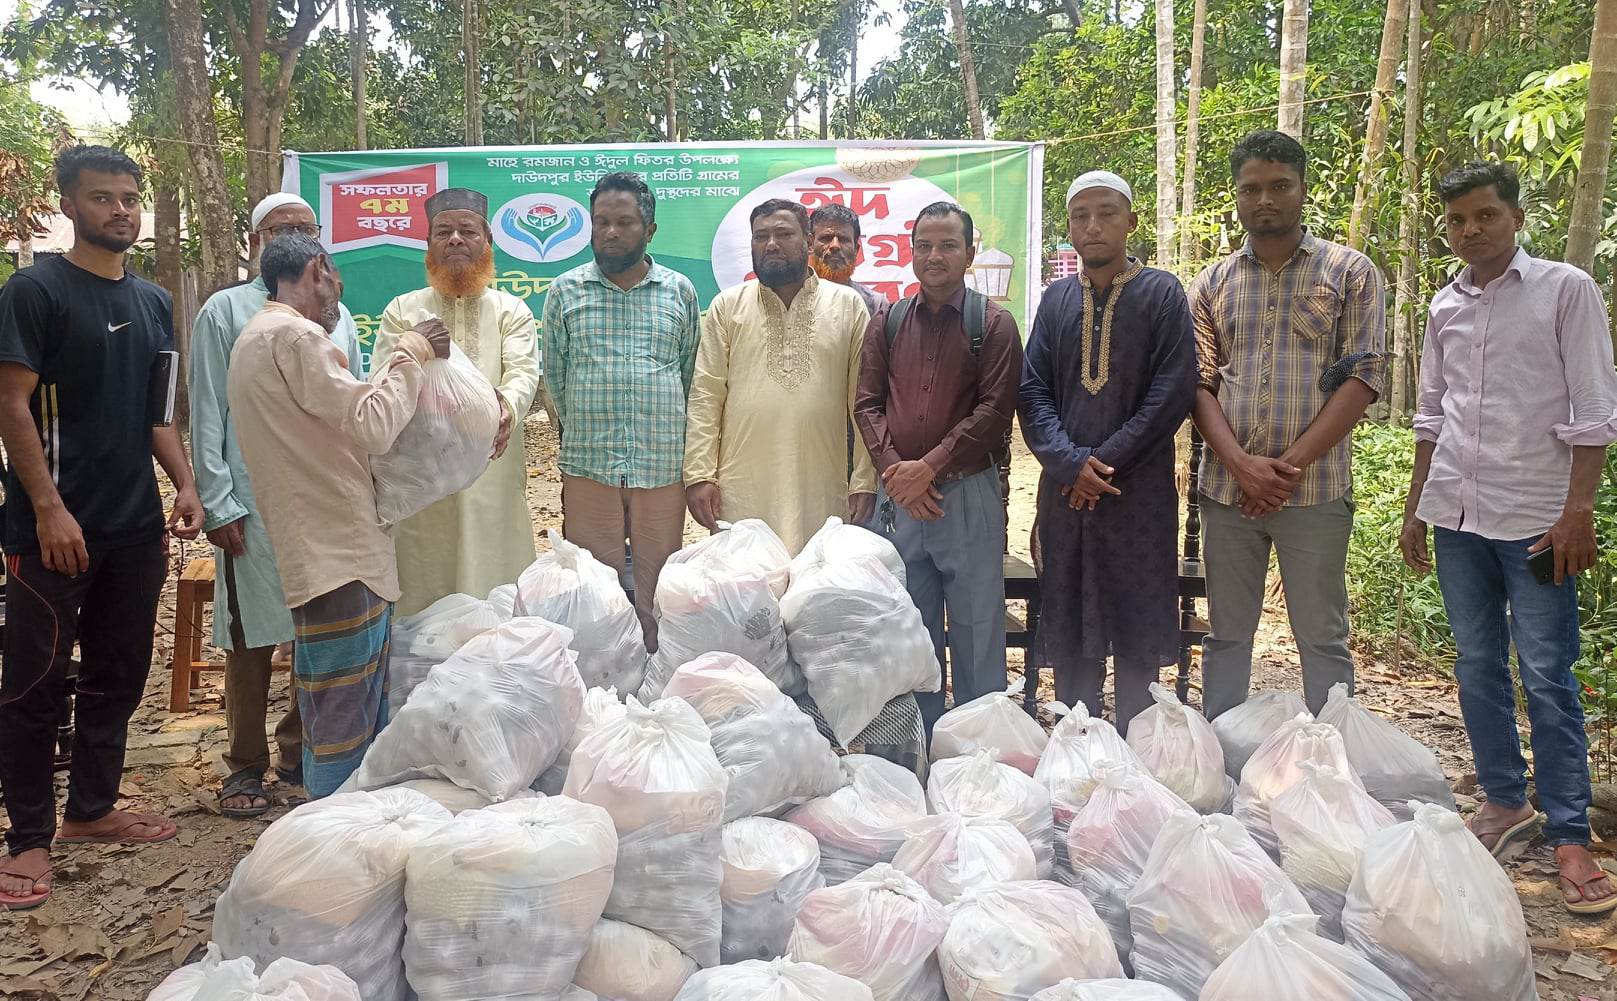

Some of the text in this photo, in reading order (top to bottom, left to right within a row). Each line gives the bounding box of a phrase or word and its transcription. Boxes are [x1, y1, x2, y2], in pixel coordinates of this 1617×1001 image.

[486, 157, 519, 168] মাহে
[522, 156, 575, 167] রমজান
[578, 156, 590, 166] ও
[594, 154, 629, 169] ঈদুল
[633, 152, 675, 166] ফিতর
[511, 170, 570, 186] দাউদপুর
[651, 168, 694, 181] প্রতিটি
[696, 170, 740, 181] গ্রামের
[339, 183, 429, 197] সফলতার
[704, 186, 740, 197] মাঝে
[356, 216, 413, 232] বছরে
